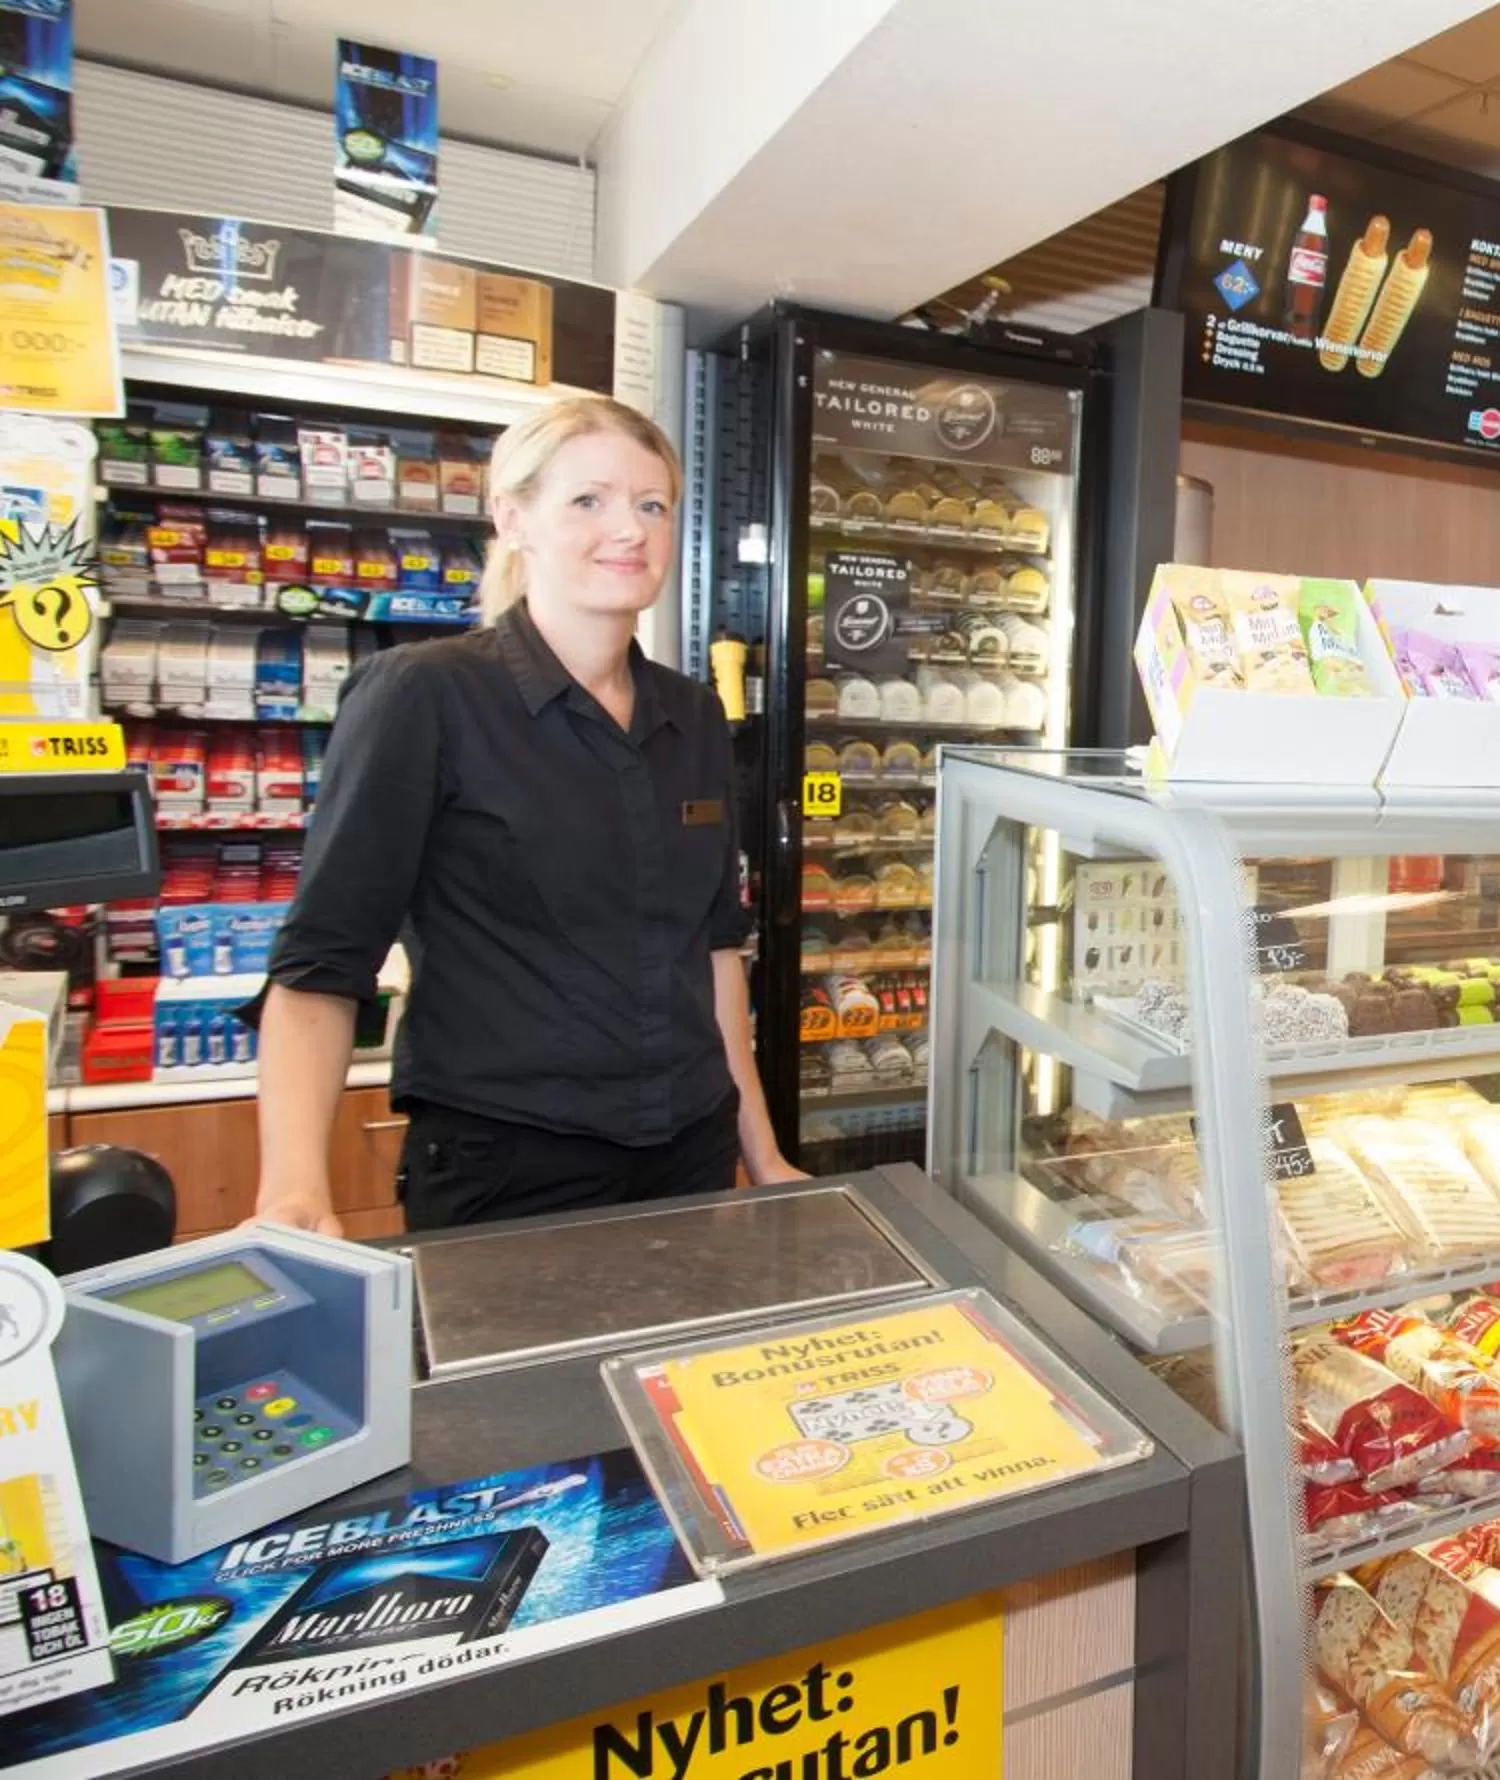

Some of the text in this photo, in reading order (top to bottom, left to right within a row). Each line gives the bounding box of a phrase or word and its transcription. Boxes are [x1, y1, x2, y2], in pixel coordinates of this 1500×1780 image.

[1219, 239, 1265, 261] MENY
[814, 393, 931, 423] TAILORED
[852, 419, 896, 434] WHITE
[830, 564, 907, 581] TAILORED
[49, 737, 109, 756] TRISS
[807, 782, 837, 803] 18
[711, 1329, 945, 1389] Bonusrutan!
[760, 1326, 881, 1363] Nyhet:
[823, 1361, 902, 1389] TRISS
[792, 1455, 1057, 1531] Fler sätt att vinna.
[219, 1485, 506, 1570] ICEBLAST
[215, 1510, 496, 1583] CLICK FOR MORE FRESHNESS
[30, 1583, 68, 1612] 18
[266, 1590, 475, 1648] Marlboro
[272, 1642, 511, 1716] Rökning dödar.
[593, 1662, 855, 1780] Nyhet:
